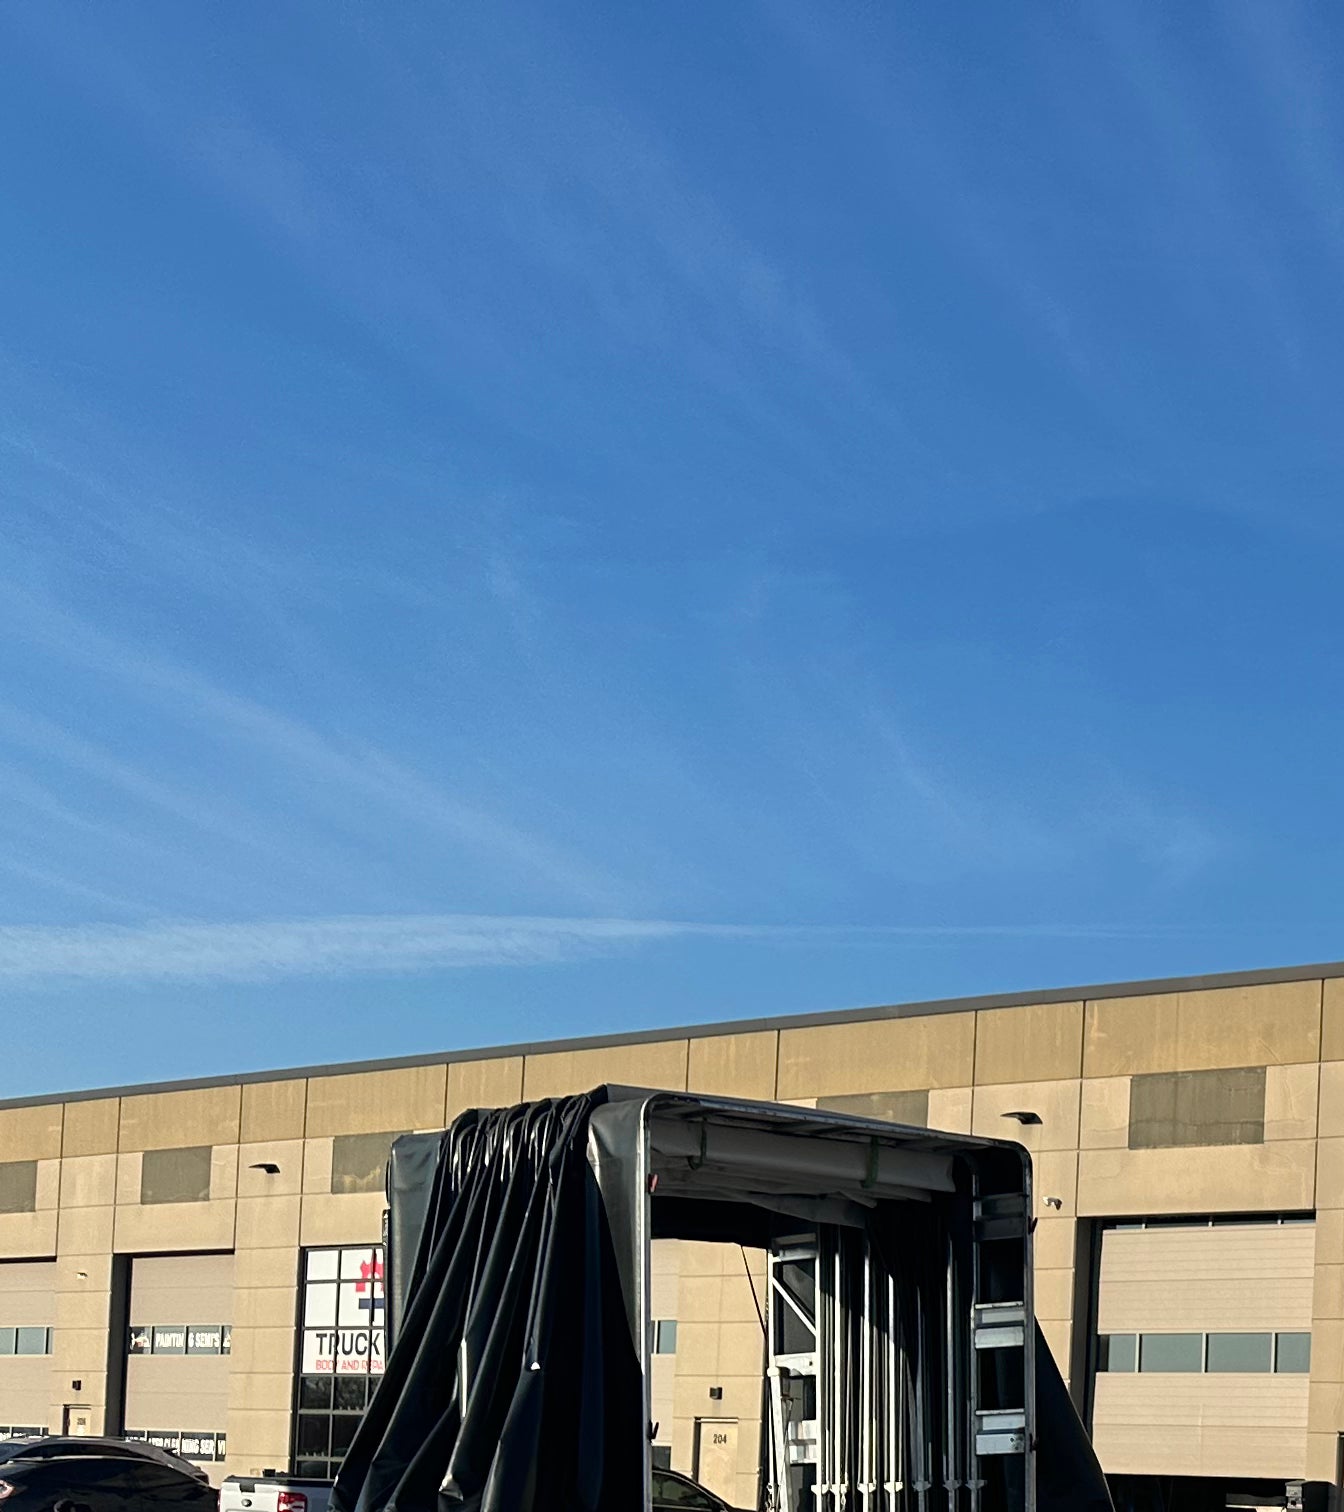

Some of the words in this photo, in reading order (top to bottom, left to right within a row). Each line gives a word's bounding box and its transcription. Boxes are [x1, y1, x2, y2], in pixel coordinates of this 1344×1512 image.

[316, 1333, 381, 1355] TRUCK
[341, 1360, 360, 1370] AND
[712, 1433, 727, 1444] 204
